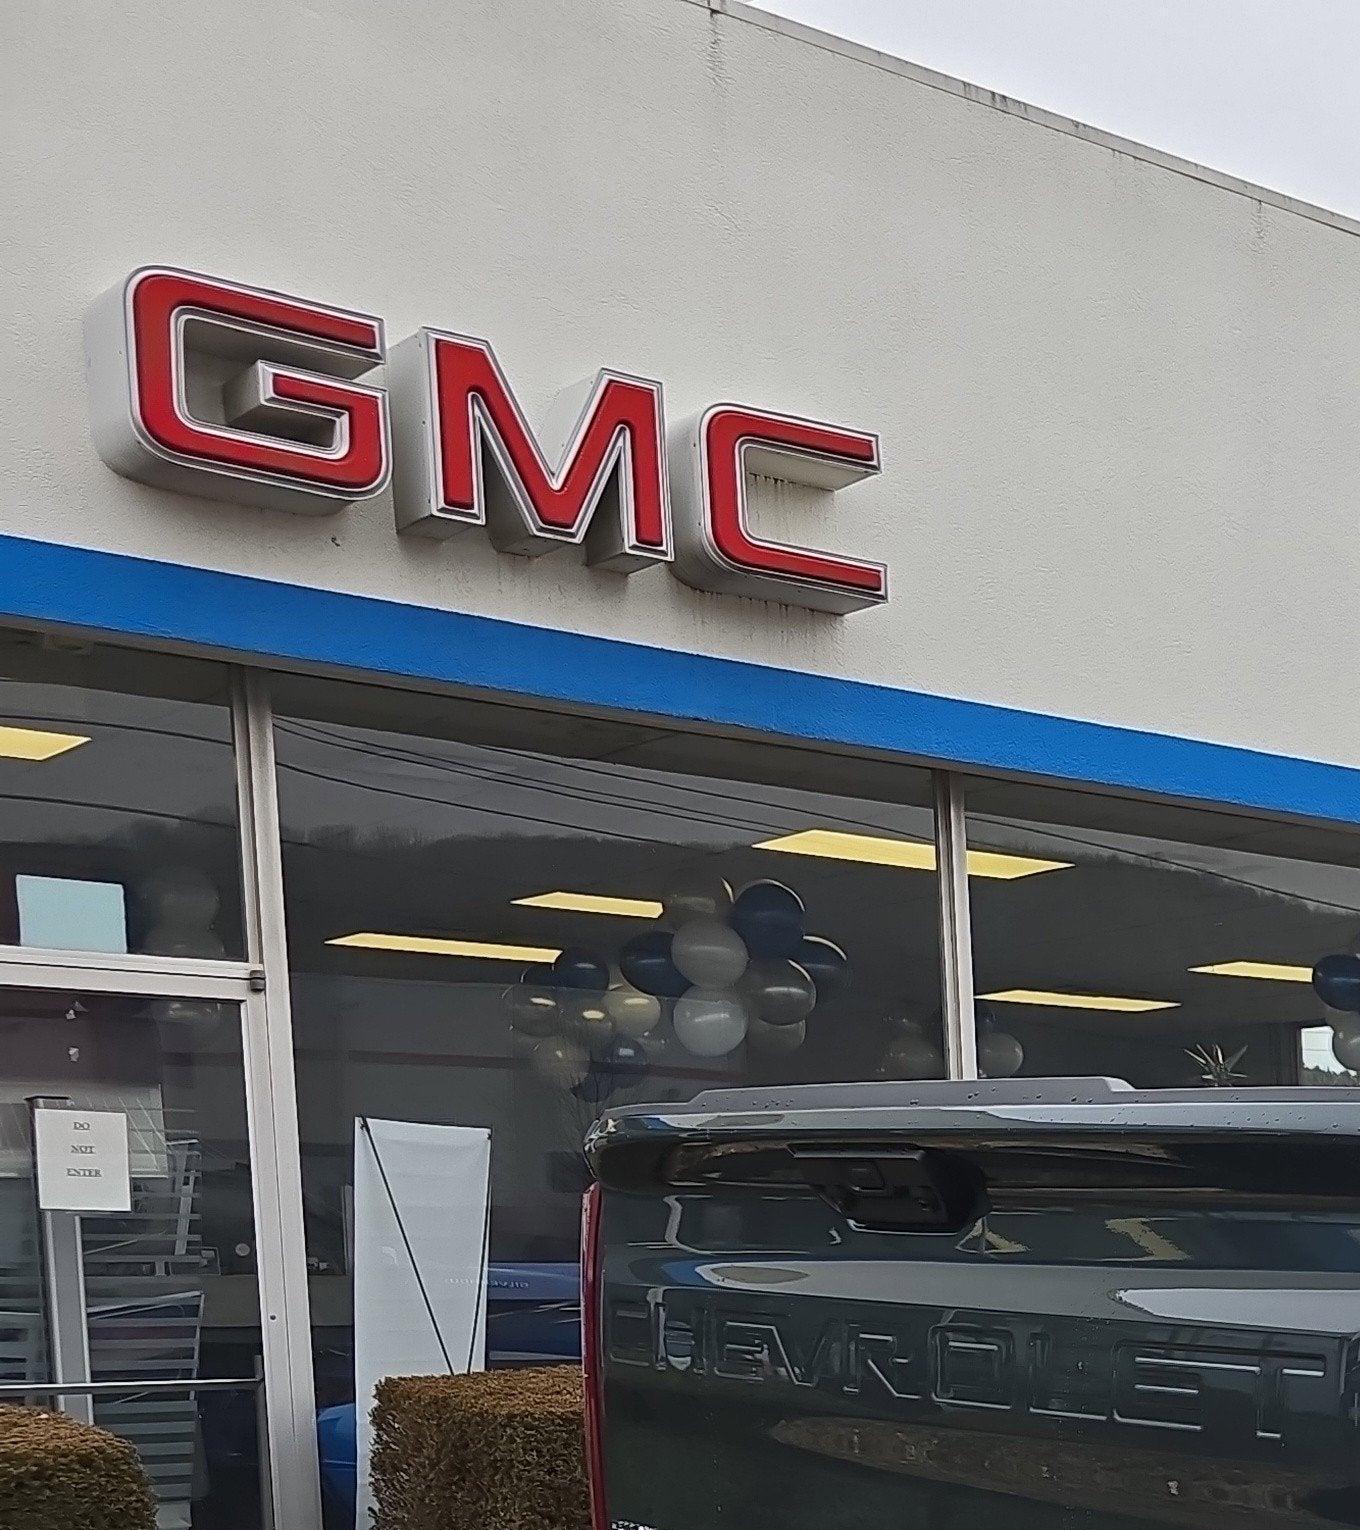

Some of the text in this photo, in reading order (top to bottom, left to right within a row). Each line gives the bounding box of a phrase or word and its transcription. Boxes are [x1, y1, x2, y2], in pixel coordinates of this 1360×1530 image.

[122, 265, 889, 606] GMC
[73, 1121, 91, 1131] DO
[70, 1144, 97, 1155] NOT
[66, 1167, 102, 1178] ENTER
[607, 1298, 1328, 1438] CHEVROLET
